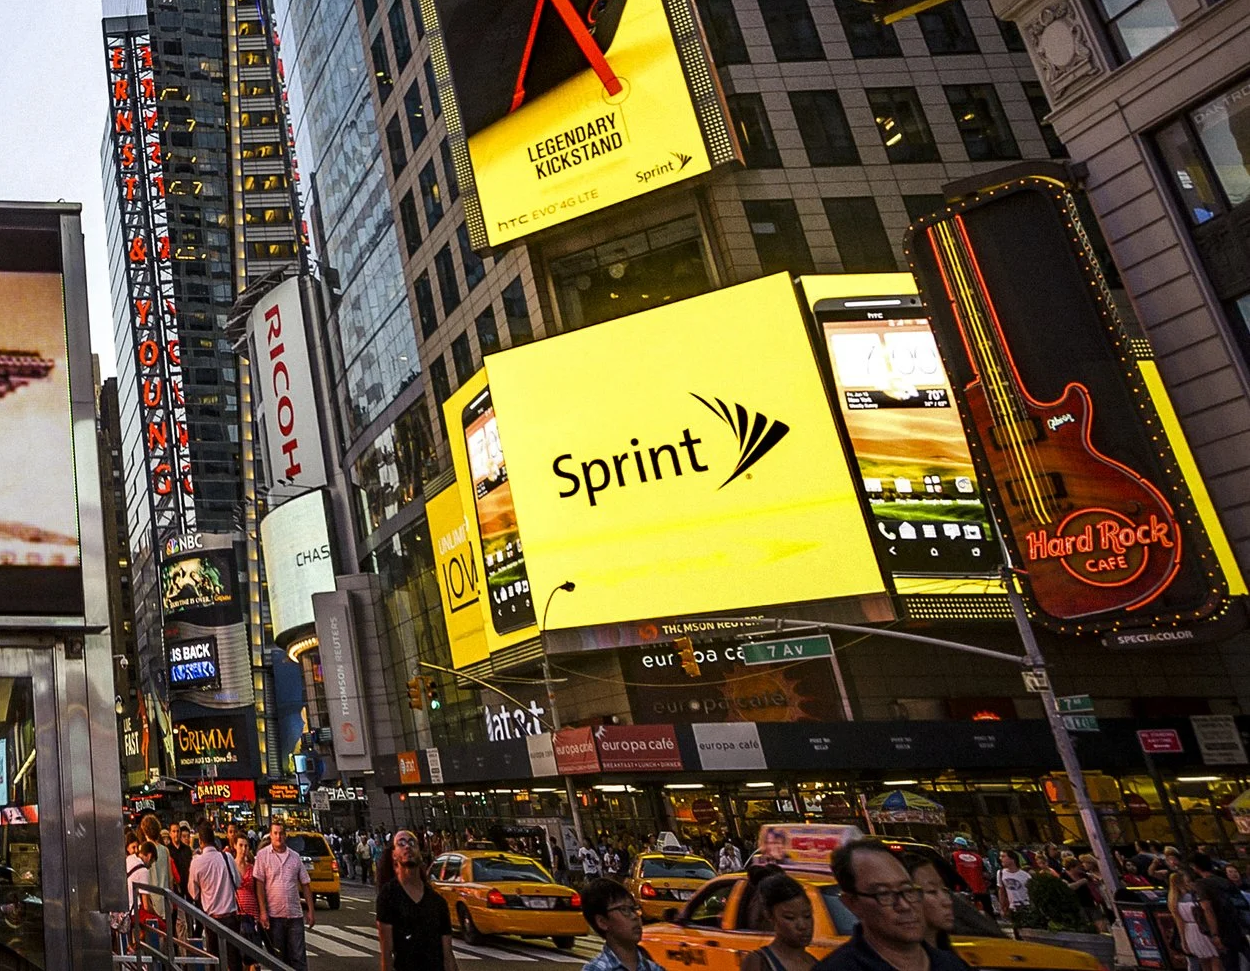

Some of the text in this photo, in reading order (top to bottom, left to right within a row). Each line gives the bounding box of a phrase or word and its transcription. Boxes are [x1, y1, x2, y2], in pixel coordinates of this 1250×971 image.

[527, 112, 616, 164] LEGENDARY
[535, 131, 623, 180] KICKSTAND
[635, 160, 674, 185] Sprint
[560, 197, 576, 212] 4G
[577, 189, 599, 206] LTE
[111, 46, 173, 496] ERNST & YOUNG
[264, 304, 302, 480] RICOH
[552, 428, 709, 506] Sprint
[179, 534, 203, 551] NBC
[1026, 515, 1174, 560] Hard Rock
[296, 544, 330, 568] CHAS
[1085, 554, 1128, 572] CAFE
[662, 621, 715, 635] THOMSON
[1117, 630, 1194, 646] SPECTACOLOR
[183, 643, 210, 660] BACK
[642, 647, 718, 668] eurpa
[767, 643, 803, 658] 7 Av
[330, 616, 349, 717] THOMSON REUTERS
[492, 700, 546, 741] at&t
[124, 731, 139, 756] FAST
[179, 724, 235, 754] GRIMM
[601, 738, 675, 754] europa café
[699, 739, 760, 752] europa café
[317, 786, 363, 800] HASE
